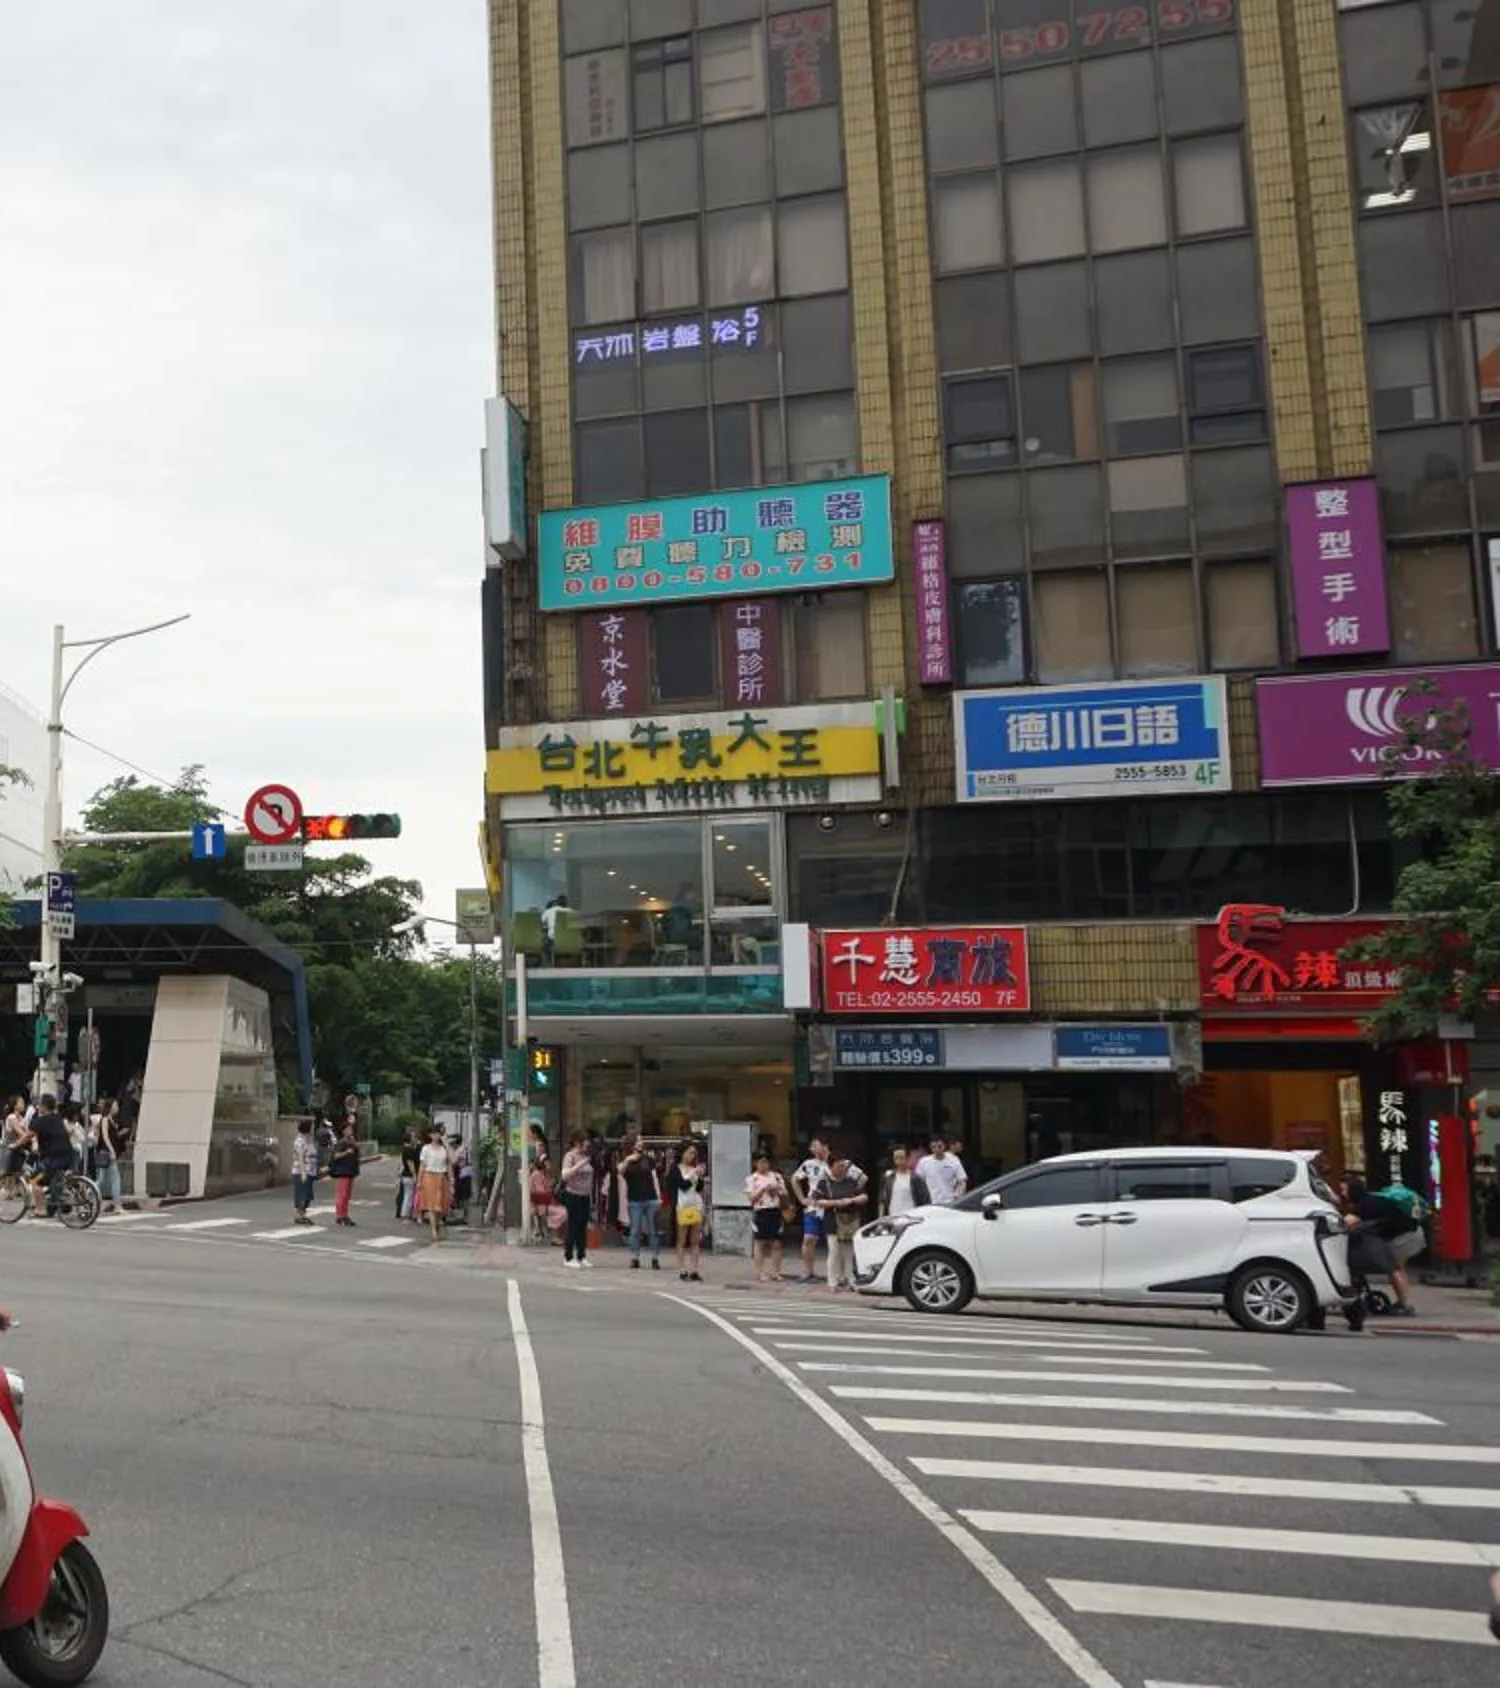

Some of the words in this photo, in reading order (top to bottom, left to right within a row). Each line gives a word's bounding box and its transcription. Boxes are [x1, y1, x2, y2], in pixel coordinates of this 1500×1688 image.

[563, 523, 862, 573] 免費聽力檢測
[1315, 488, 1359, 646] 整型手術
[563, 552, 862, 595] 0800-580-731
[599, 614, 628, 711] 京水堂
[736, 604, 765, 701] 中醫診所
[538, 712, 821, 780] 台北牛乳大王
[1005, 705, 1180, 754] 德川日語
[543, 783, 647, 813] Taipei
[656, 779, 735, 807] Milk
[748, 774, 830, 804] King
[1114, 764, 1187, 780] 2555-5853
[1194, 762, 1221, 785] 4F
[49, 875, 62, 898] P
[831, 933, 1018, 989] 千慧商旅
[835, 990, 982, 1008] TEL:02-2555-2450
[995, 990, 1017, 1006] 7F
[533, 1051, 550, 1069] 31
